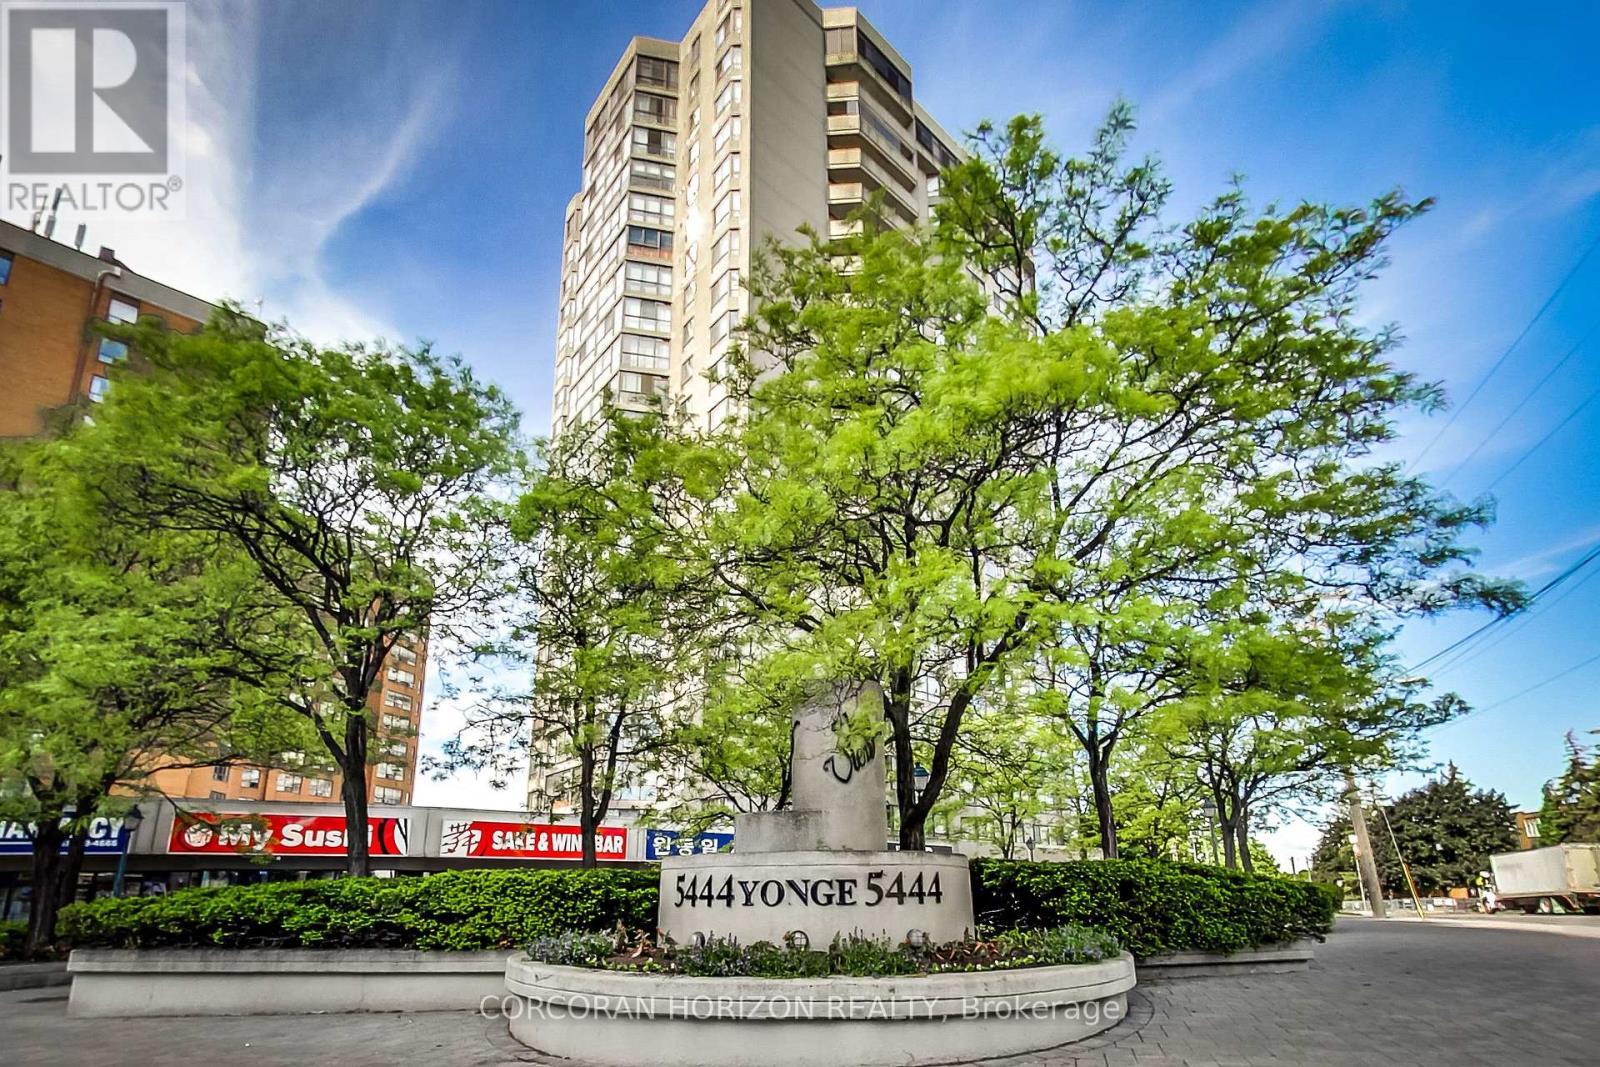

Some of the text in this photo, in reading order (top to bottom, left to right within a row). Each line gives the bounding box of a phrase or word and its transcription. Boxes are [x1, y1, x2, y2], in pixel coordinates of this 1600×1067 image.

[281, 823, 373, 847] Susi
[537, 832, 549, 852] &
[551, 833, 583, 853] WIN
[594, 835, 624, 854] BAR
[674, 870, 943, 908] 5444 YONGE 5444
